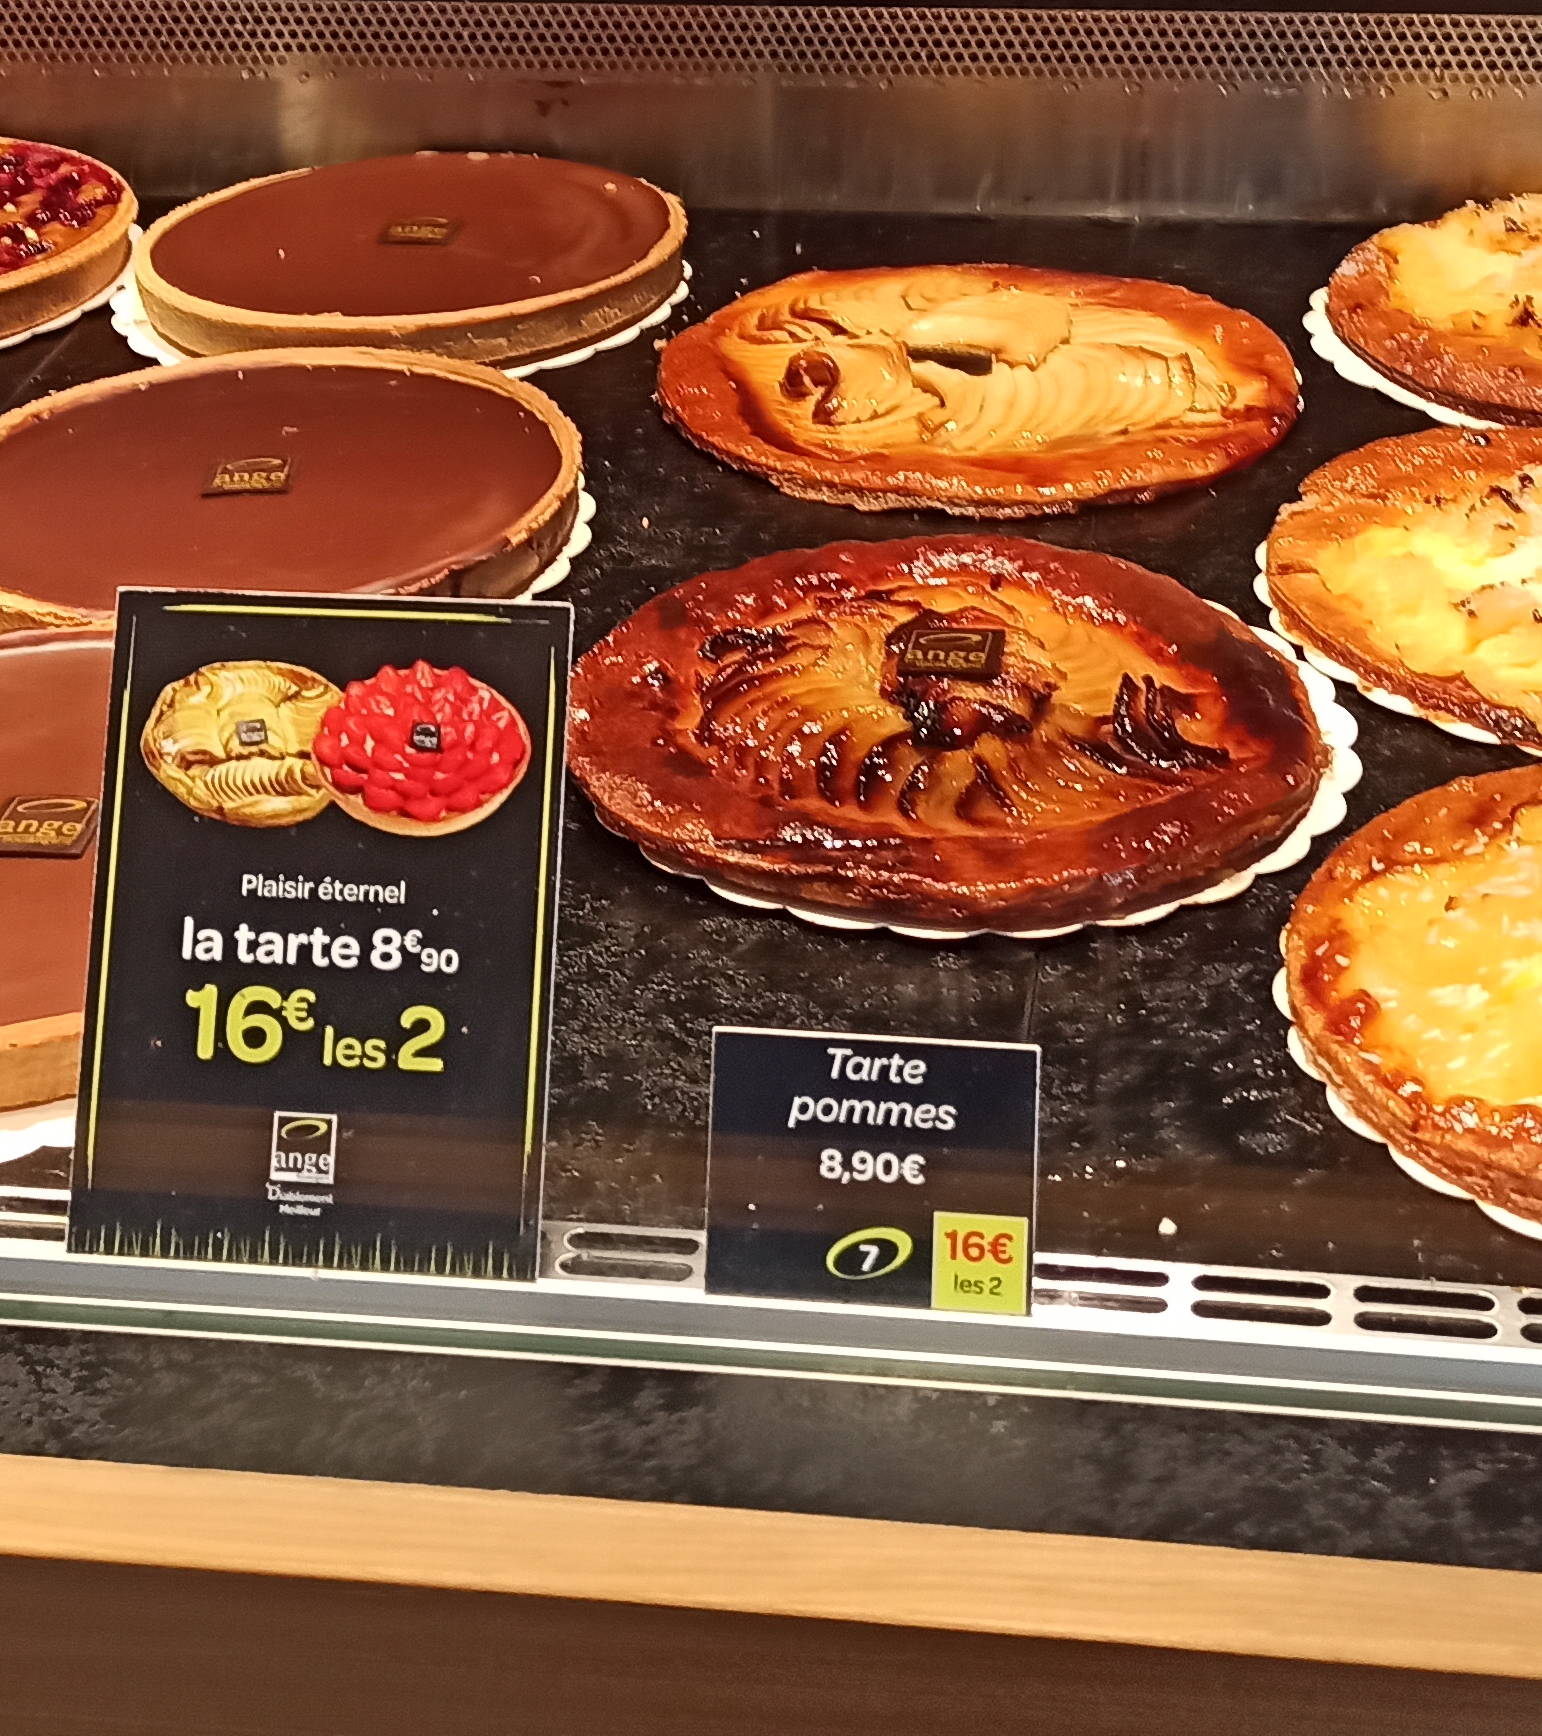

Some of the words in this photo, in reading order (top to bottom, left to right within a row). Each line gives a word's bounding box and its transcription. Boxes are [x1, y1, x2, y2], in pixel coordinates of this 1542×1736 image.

[241, 873, 315, 900] Plaisir
[317, 876, 406, 904] éternel
[181, 915, 224, 961] la
[234, 923, 361, 968] tarte
[185, 983, 317, 1063] 16€
[322, 1025, 387, 1068] les
[397, 1005, 446, 1072] 2
[826, 1047, 928, 1085] Tarte
[787, 1095, 959, 1131] pommes
[272, 1150, 332, 1174] ange
[819, 1148, 927, 1185] 8,90€
[859, 1244, 880, 1272] 7
[944, 1230, 1014, 1265] 16€
[953, 1274, 984, 1295] les
[988, 1276, 1003, 1297] 2
